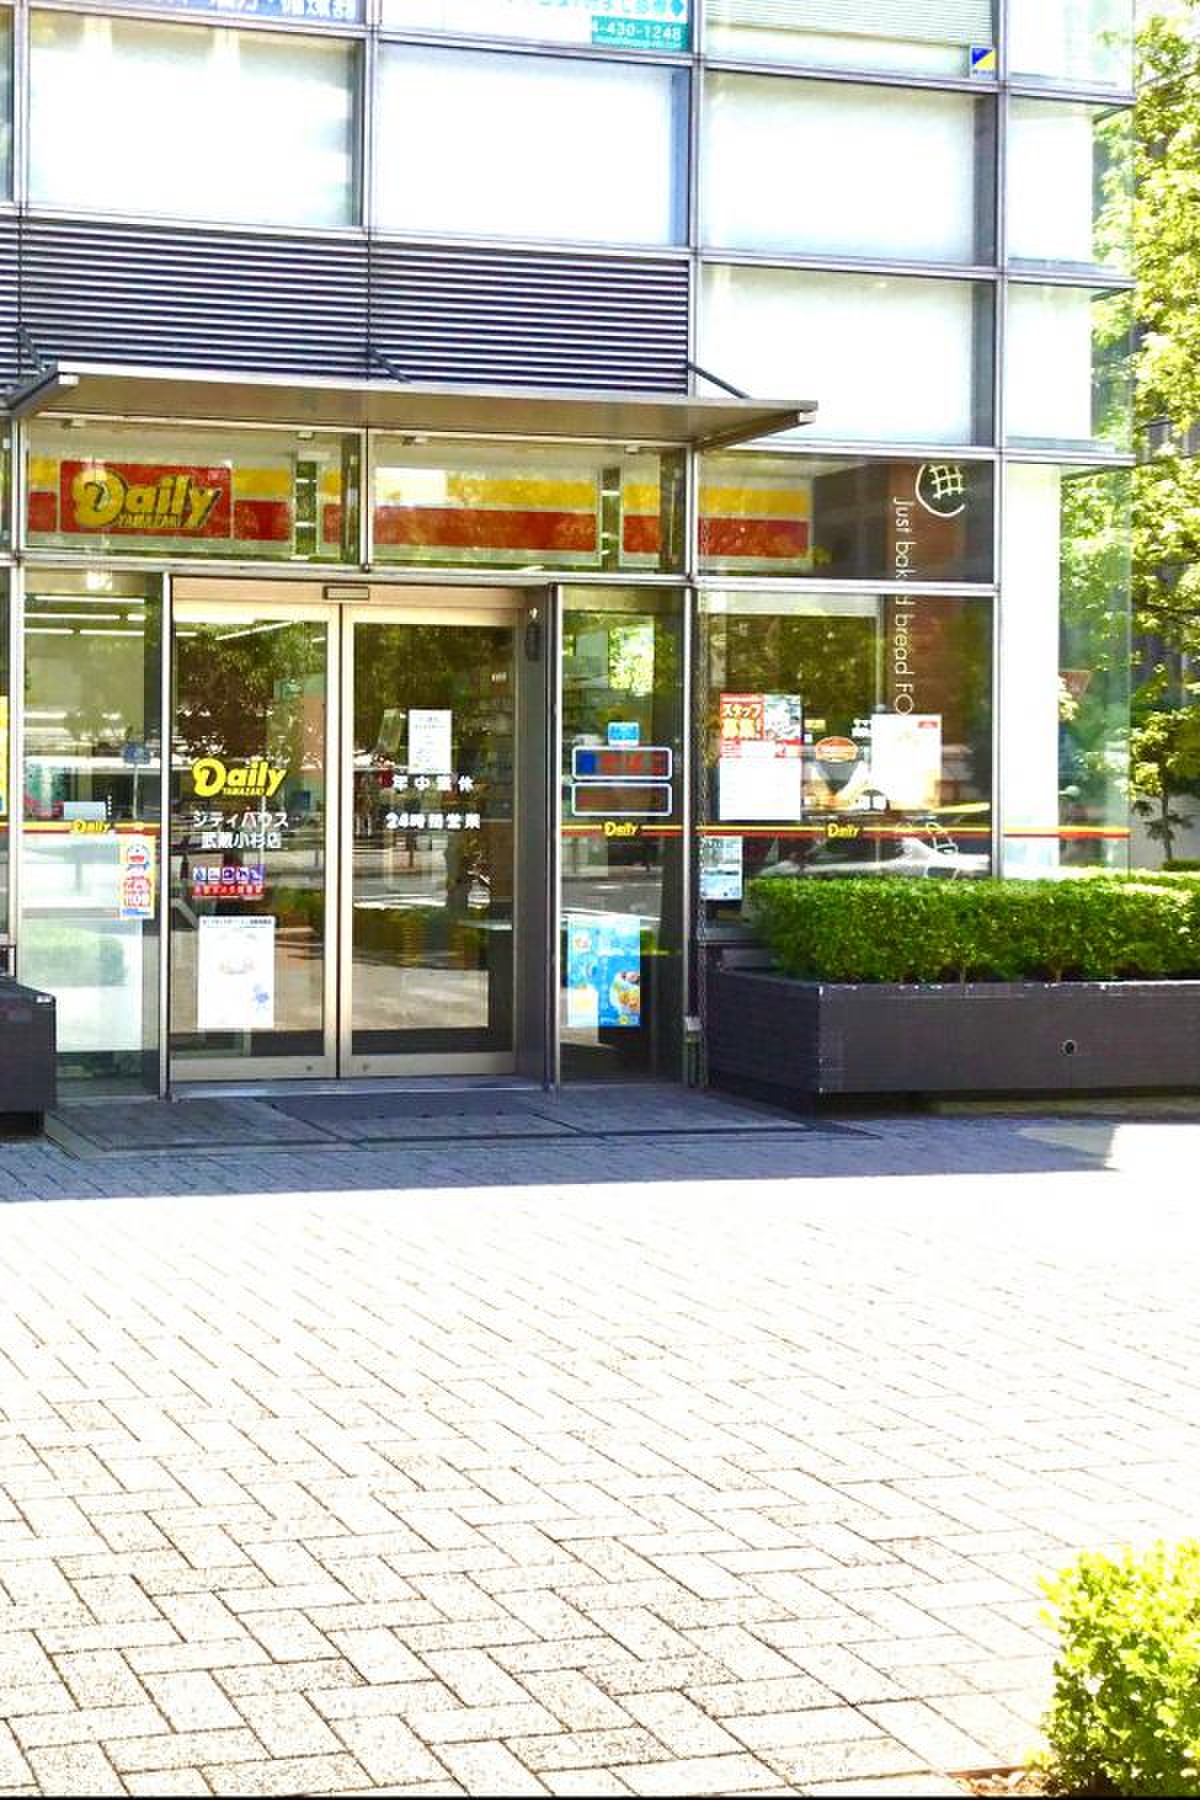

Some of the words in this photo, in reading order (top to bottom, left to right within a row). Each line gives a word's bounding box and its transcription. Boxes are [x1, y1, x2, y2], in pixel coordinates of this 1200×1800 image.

[72, 468, 223, 528] Daily
[895, 541, 918, 605] bakd
[894, 614, 915, 675] bread
[192, 757, 287, 798] Daily
